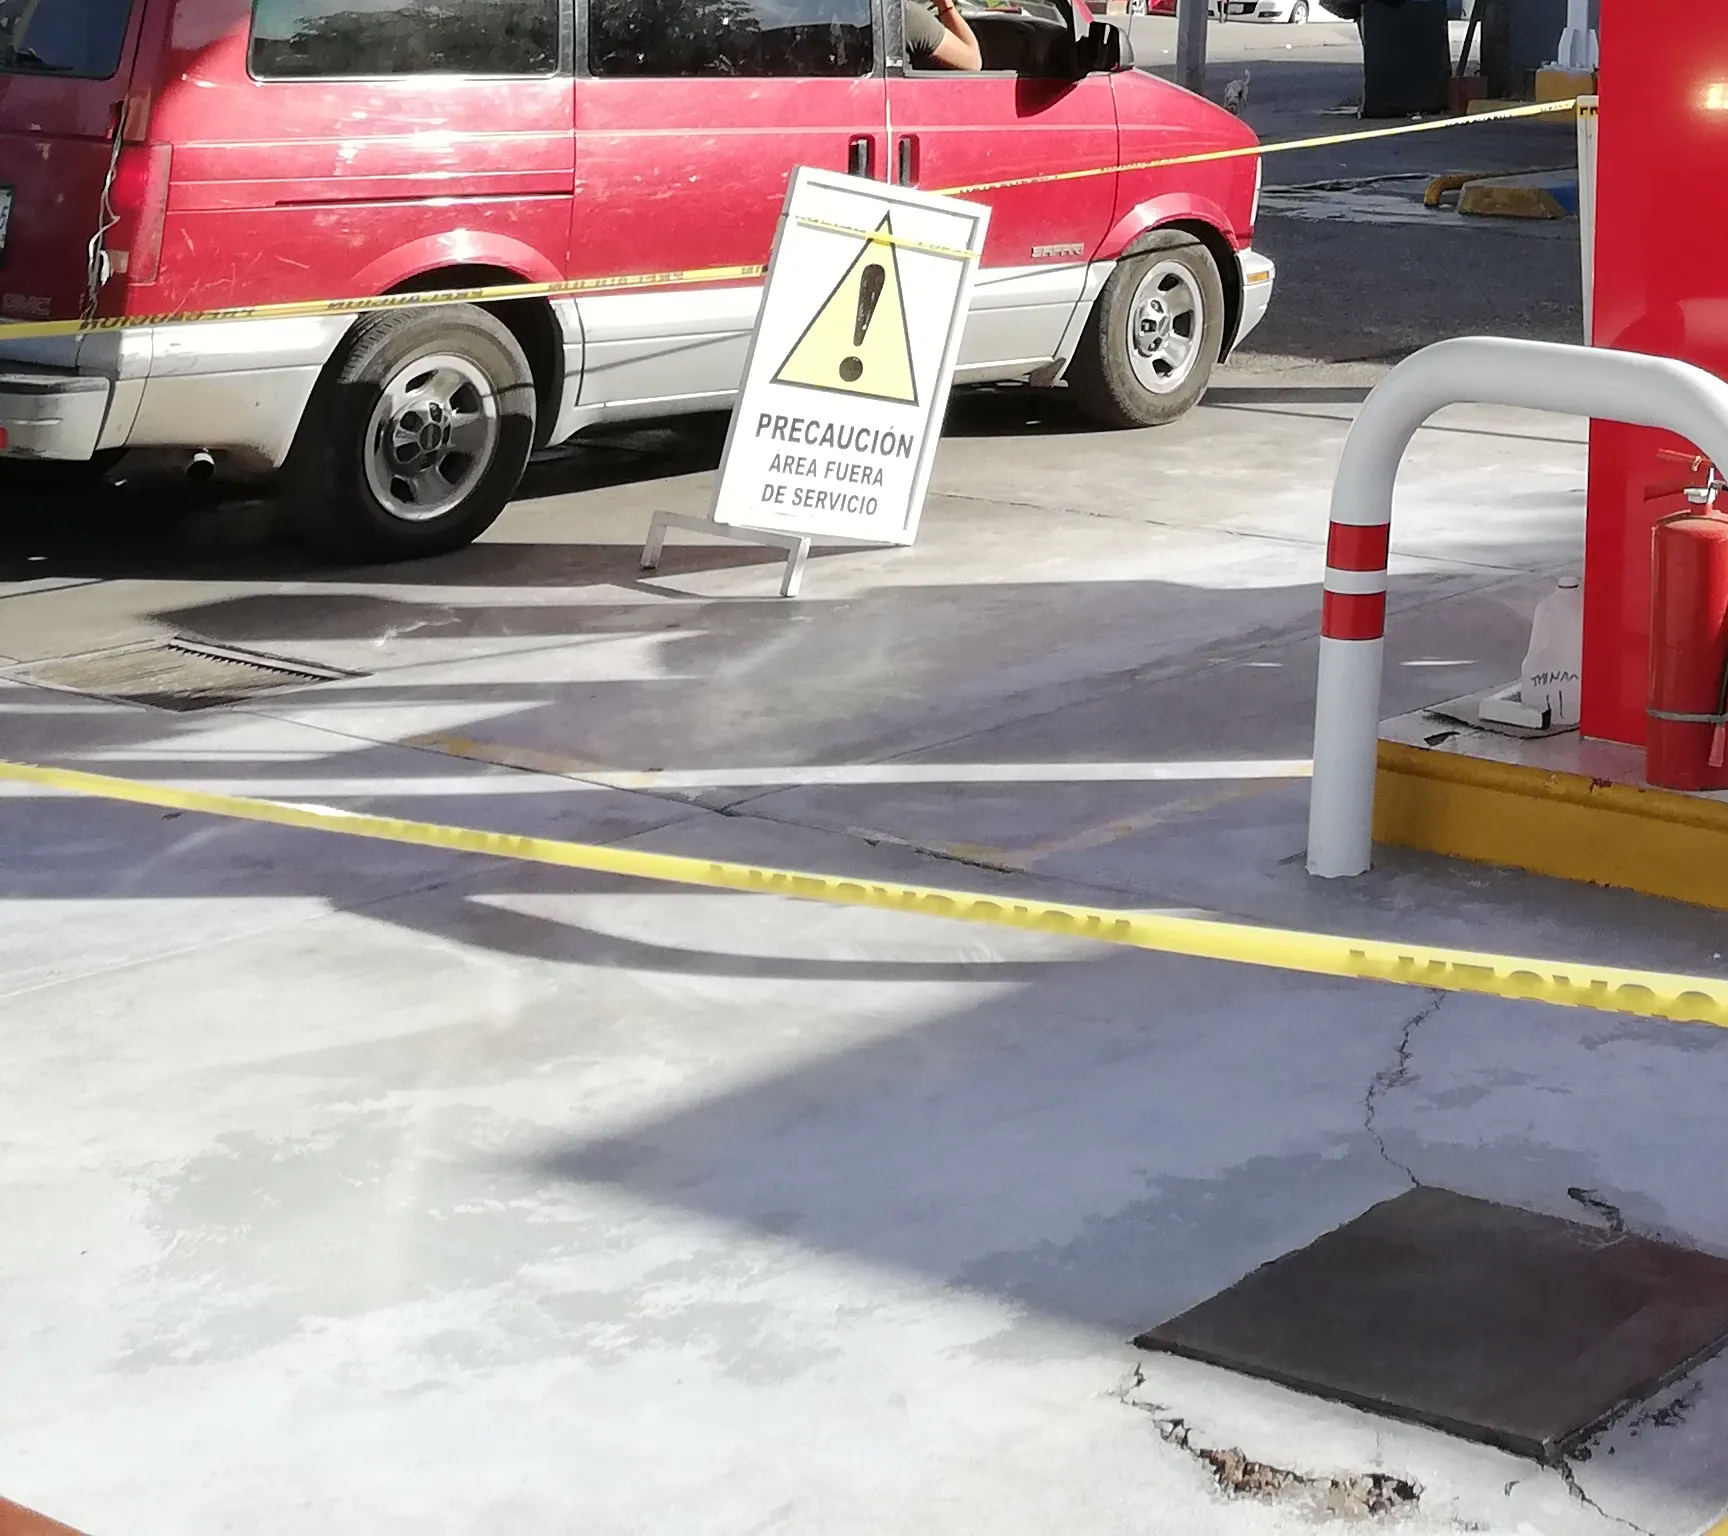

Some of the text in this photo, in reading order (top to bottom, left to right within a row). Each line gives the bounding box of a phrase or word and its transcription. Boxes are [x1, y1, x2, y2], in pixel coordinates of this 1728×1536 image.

[2, 293, 51, 315] GMC
[755, 412, 914, 459] PRECAUCIÓN
[824, 460, 884, 487] FUERA
[761, 483, 878, 516] DE SERVICIO
